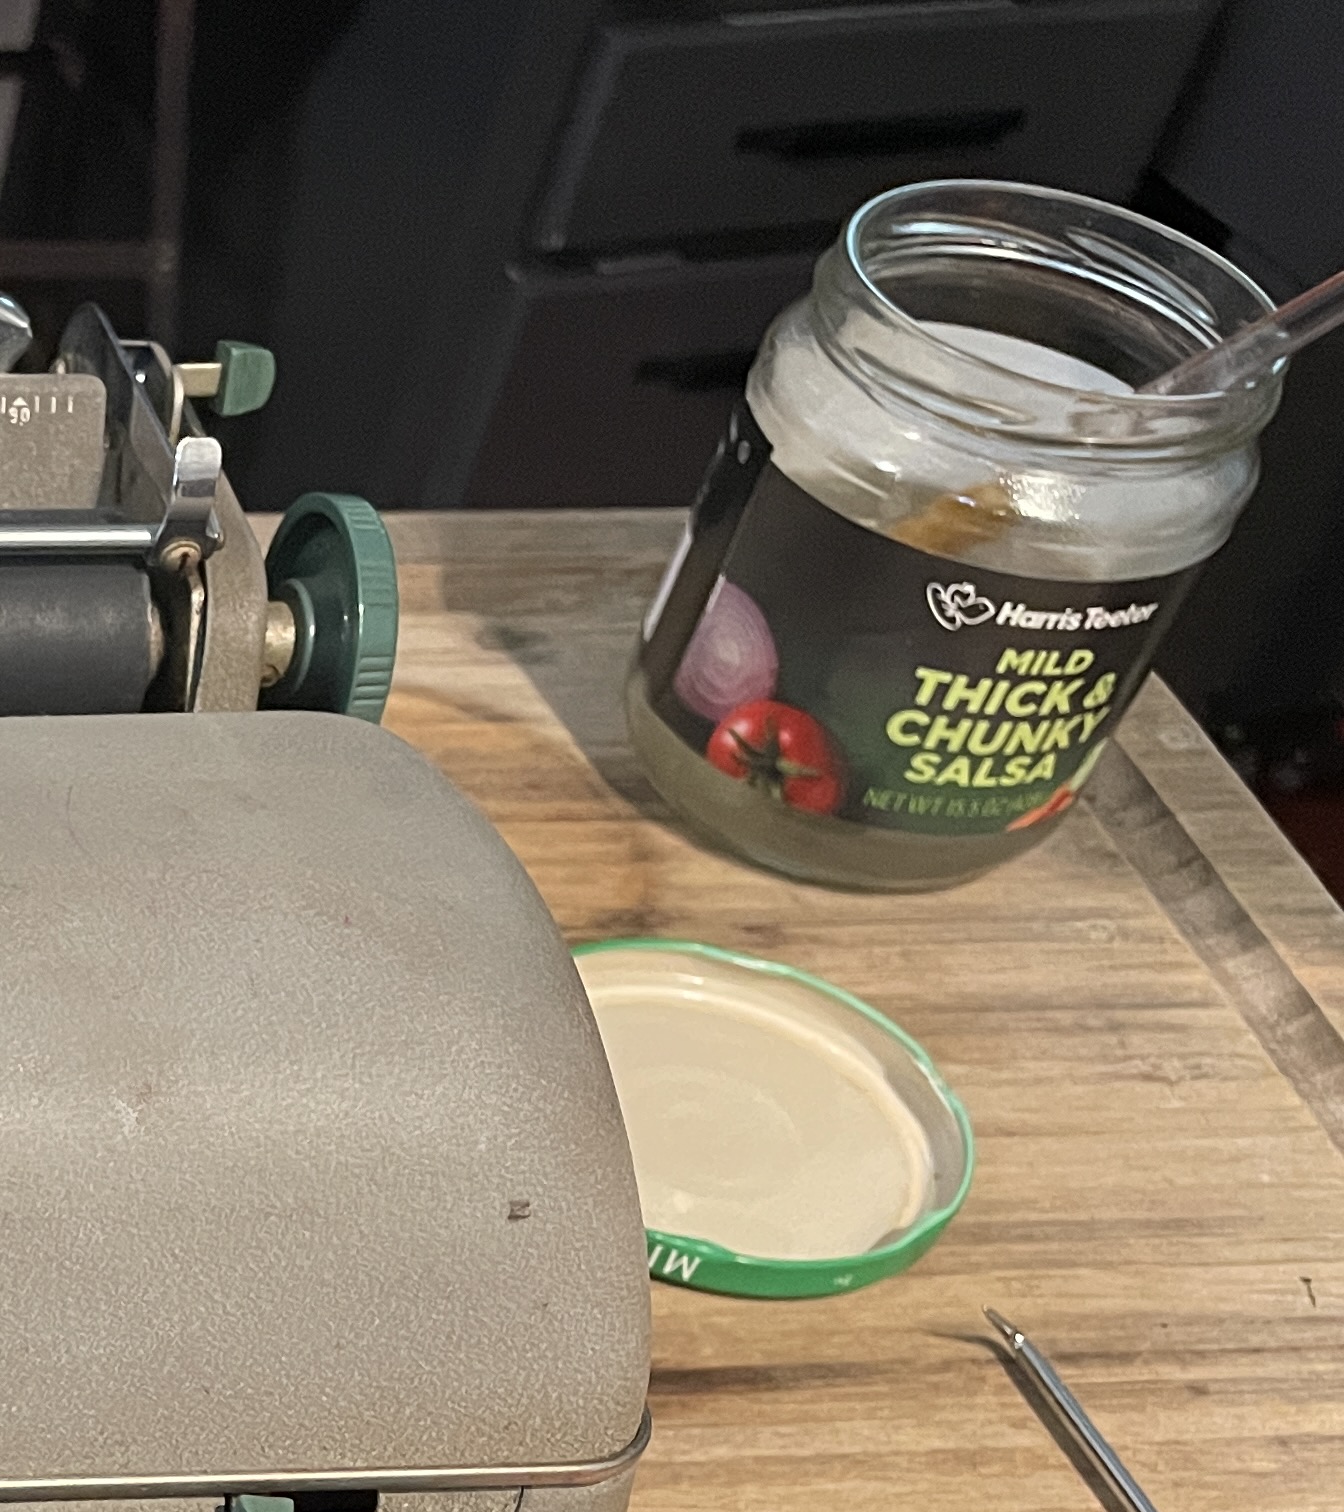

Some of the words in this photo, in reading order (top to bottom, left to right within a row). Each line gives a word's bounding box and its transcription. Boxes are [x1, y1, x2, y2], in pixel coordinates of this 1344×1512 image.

[7, 405, 32, 426] 90
[995, 601, 1082, 631] Harris
[1084, 602, 1159, 631] Teeter
[995, 647, 1095, 676] MILD
[914, 666, 1086, 718] THICK
[1082, 672, 1117, 709] &
[885, 706, 1111, 756] CHUNKY
[903, 752, 1058, 789] SALSA
